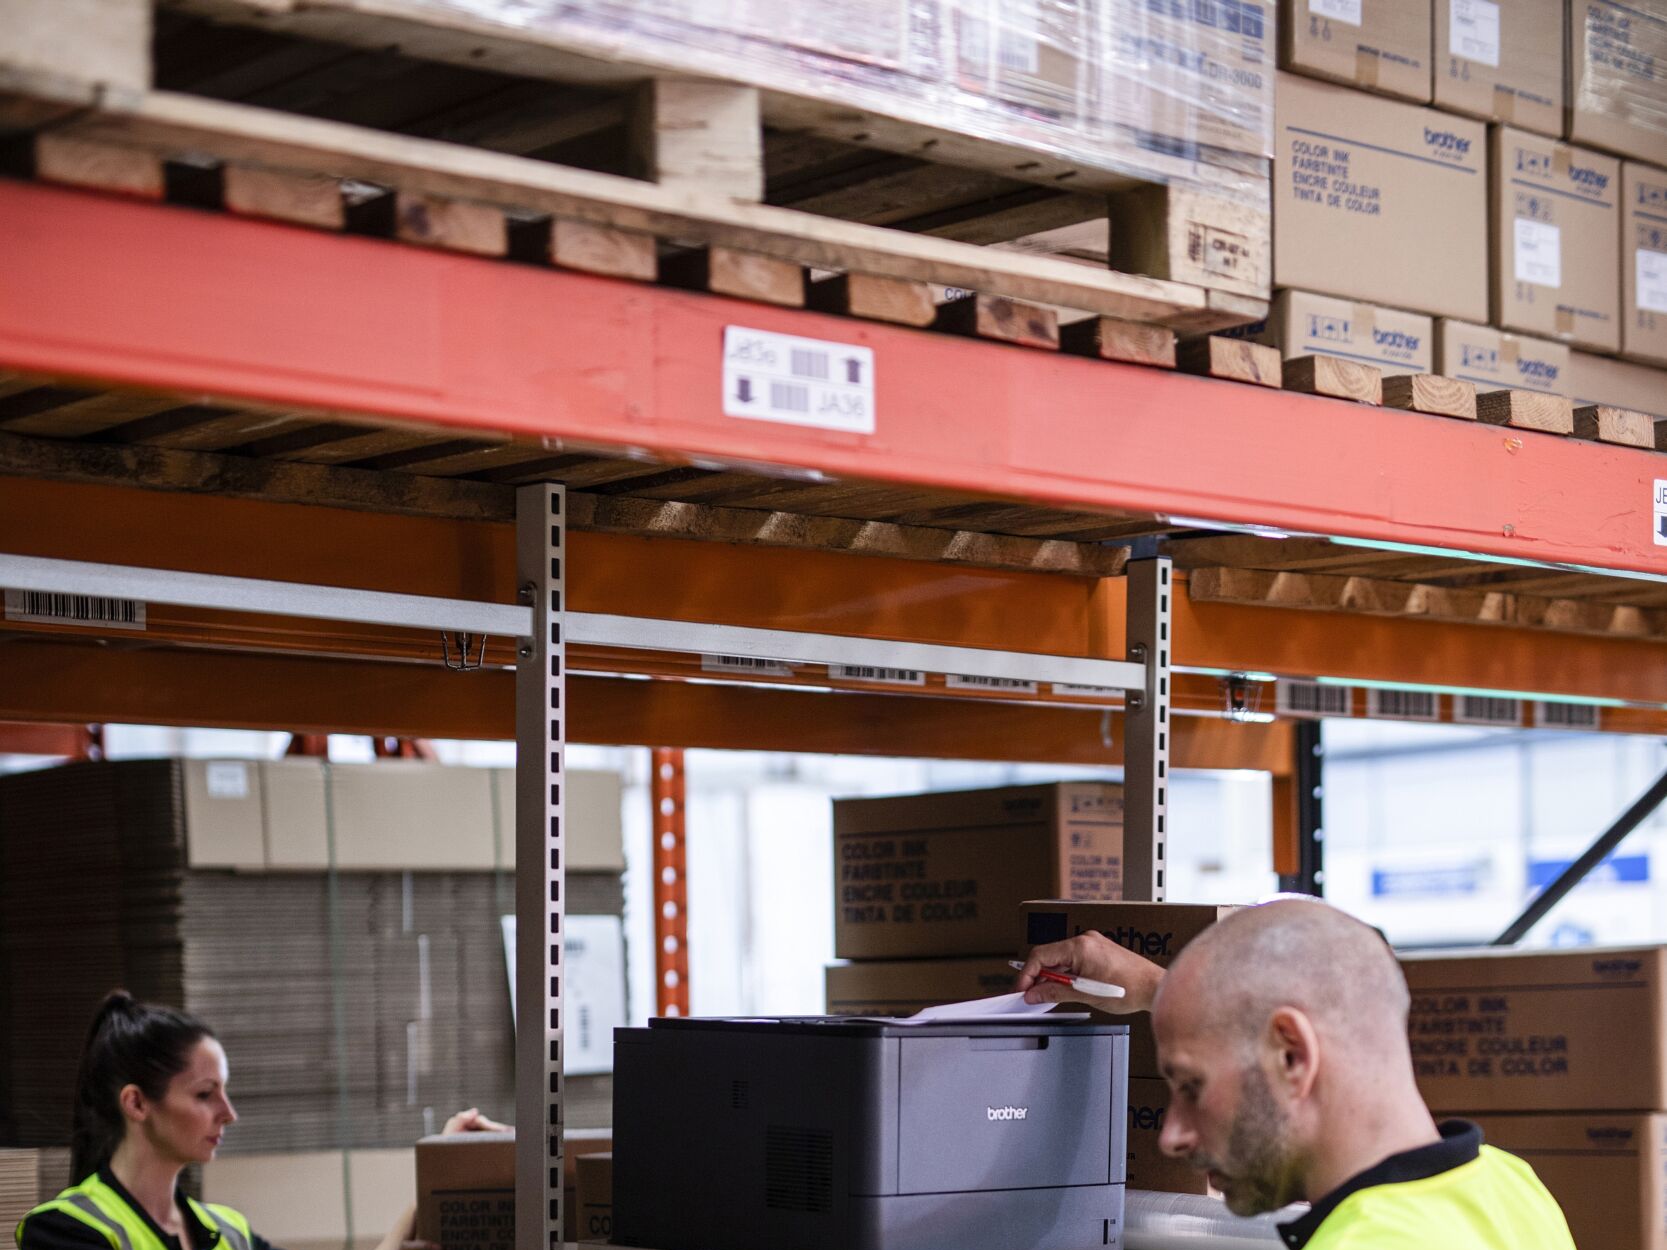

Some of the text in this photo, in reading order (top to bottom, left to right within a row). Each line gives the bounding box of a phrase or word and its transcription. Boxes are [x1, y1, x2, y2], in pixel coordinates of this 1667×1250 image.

[1424, 126, 1471, 153] brother
[1291, 140, 1350, 162] COLOR INK
[1292, 155, 1349, 178] FARBTINTE
[1293, 171, 1380, 199] ENCRE COULEUR
[1293, 187, 1380, 215] TINTA DE COLOR
[1372, 326, 1421, 351] brother
[842, 840, 896, 860] COLOR
[842, 860, 926, 881] FARBTINTE
[842, 879, 977, 901] ENCRE COULEUR
[843, 902, 978, 923] TINTA DE COLOR
[1478, 1036, 1567, 1054] COULEUR
[1468, 1058, 1491, 1074] DE
[1502, 1056, 1568, 1075] COLOR
[987, 1105, 1028, 1121] brother
[440, 1200, 515, 1213] COLOR IN
[441, 1230, 489, 1242] ENCRE
